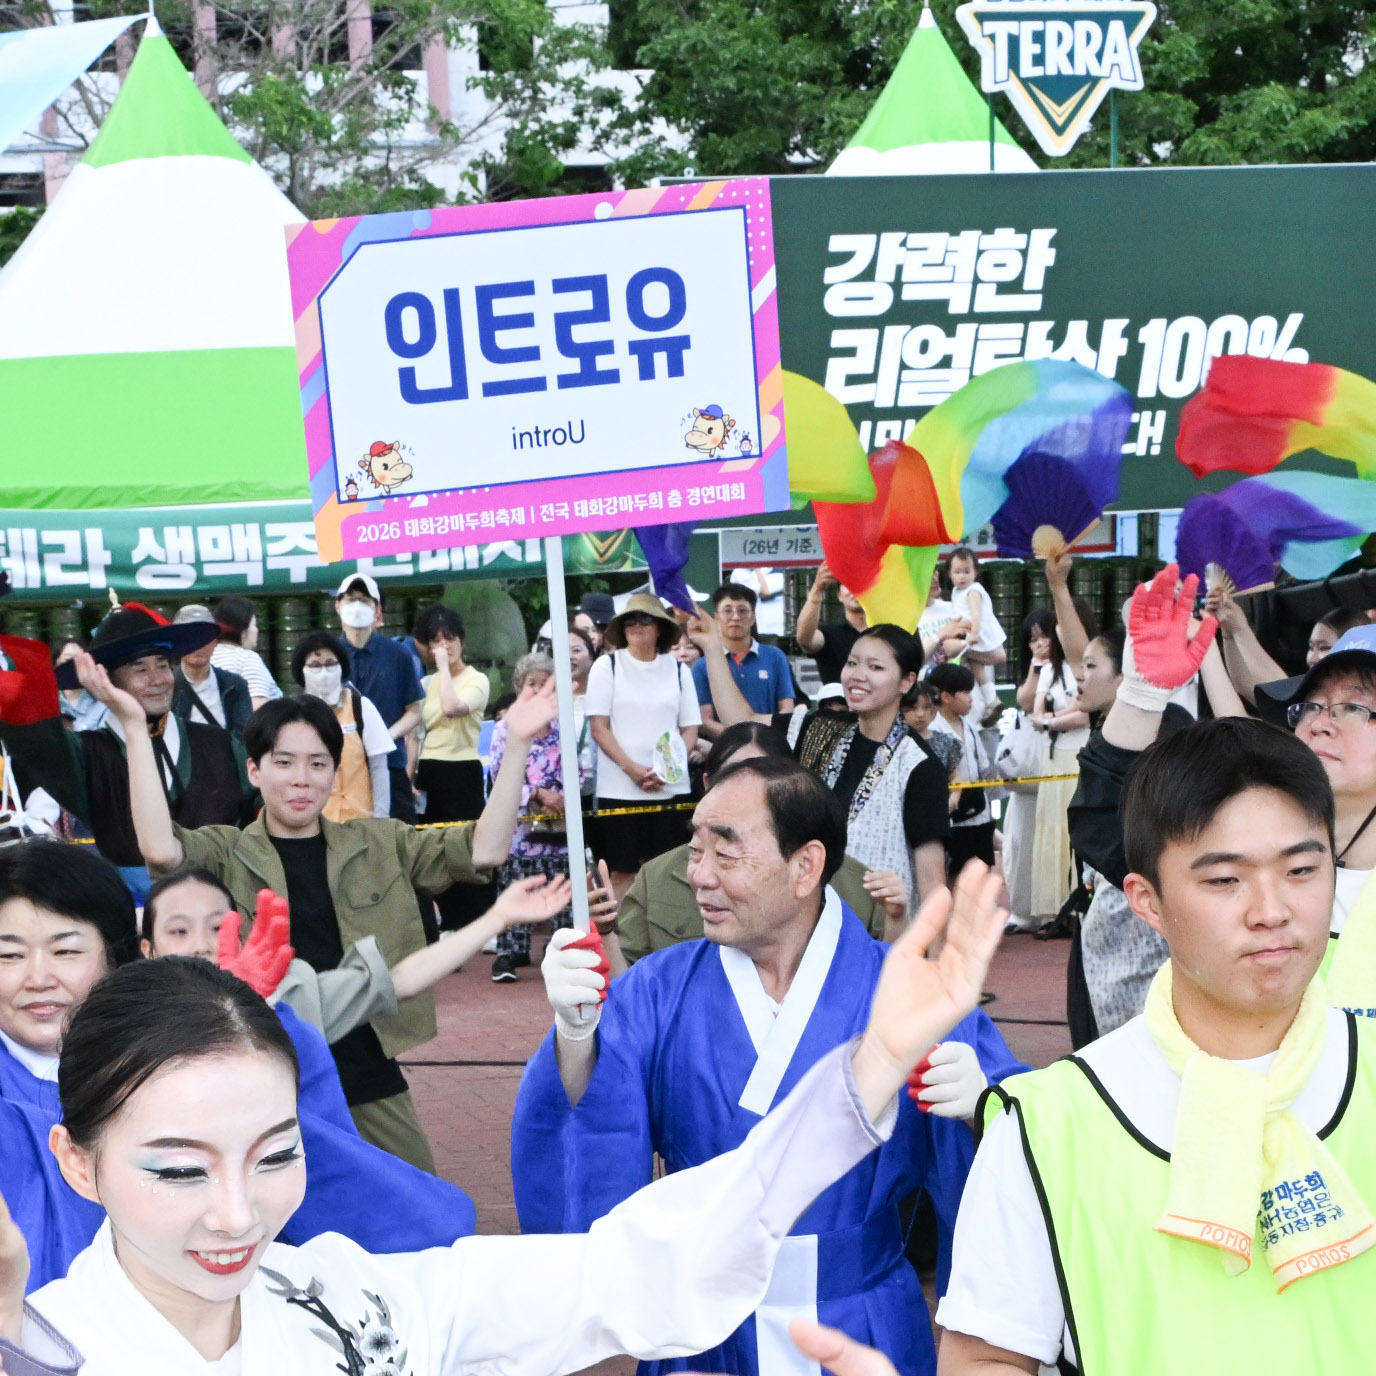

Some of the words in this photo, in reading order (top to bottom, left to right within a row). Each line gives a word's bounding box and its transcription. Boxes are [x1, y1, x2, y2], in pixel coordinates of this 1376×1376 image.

[980, 19, 1138, 91] TERRA
[824, 226, 1058, 318] 강력한
[383, 266, 692, 405] 인트로유
[512, 420, 586, 450] introU
[357, 521, 402, 543] 2026
[404, 507, 525, 538] 태화강마두희축제
[540, 502, 570, 522] 전국
[573, 491, 663, 520] 태화강마두희
[666, 490, 684, 509] 춤
[686, 481, 746, 507] 경연대회
[131, 523, 331, 588] 생맥주
[743, 538, 780, 556] (26년
[1274, 1170, 1327, 1201] 마두희
